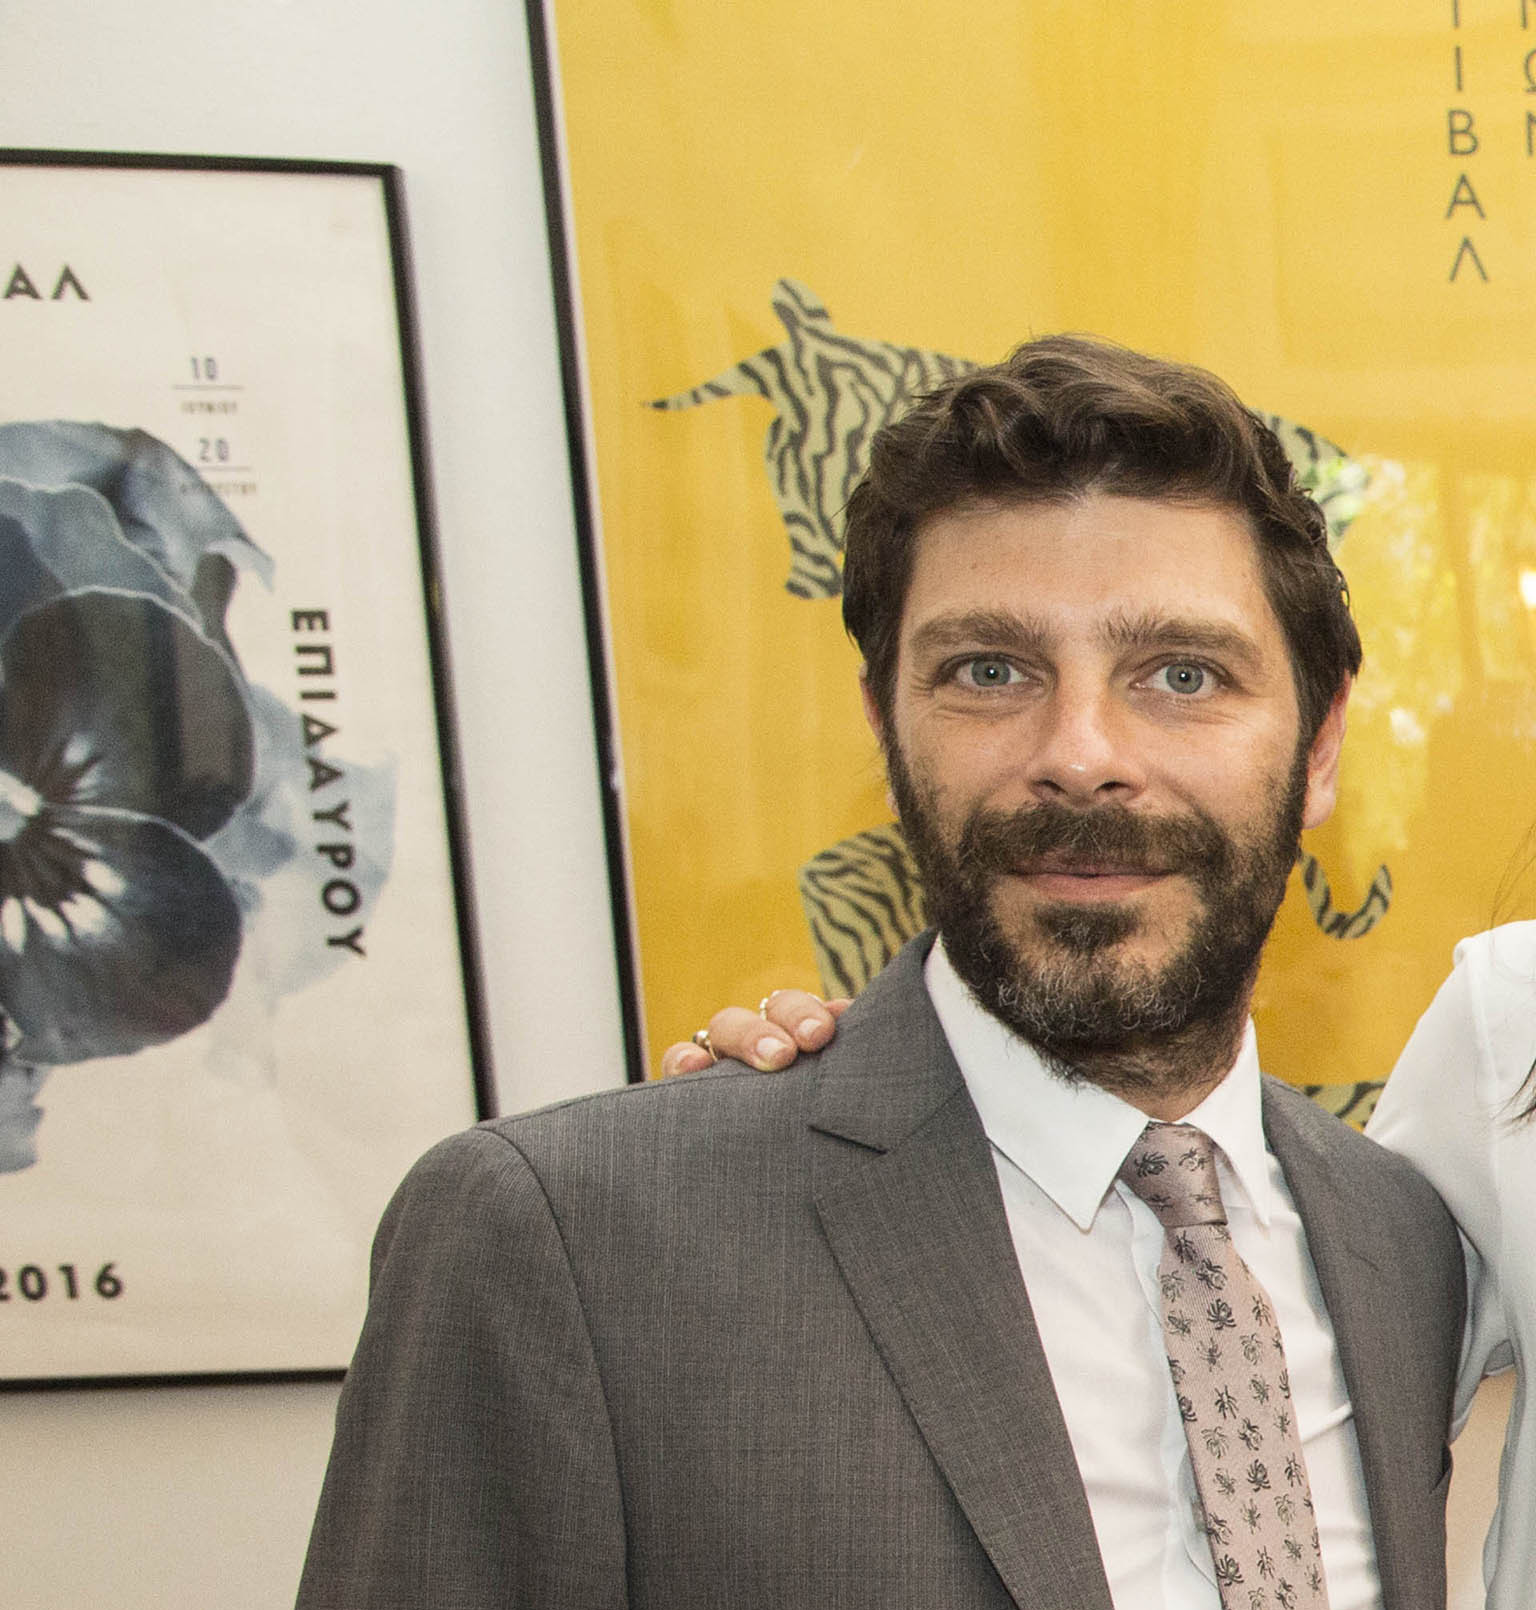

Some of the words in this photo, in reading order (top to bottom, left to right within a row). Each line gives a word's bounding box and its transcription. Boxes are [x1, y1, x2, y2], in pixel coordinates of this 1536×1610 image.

[191, 357, 217, 380] 10
[200, 438, 229, 462] 20
[292, 607, 366, 959] ΕΠΙΔΑΥΡΟΥ
